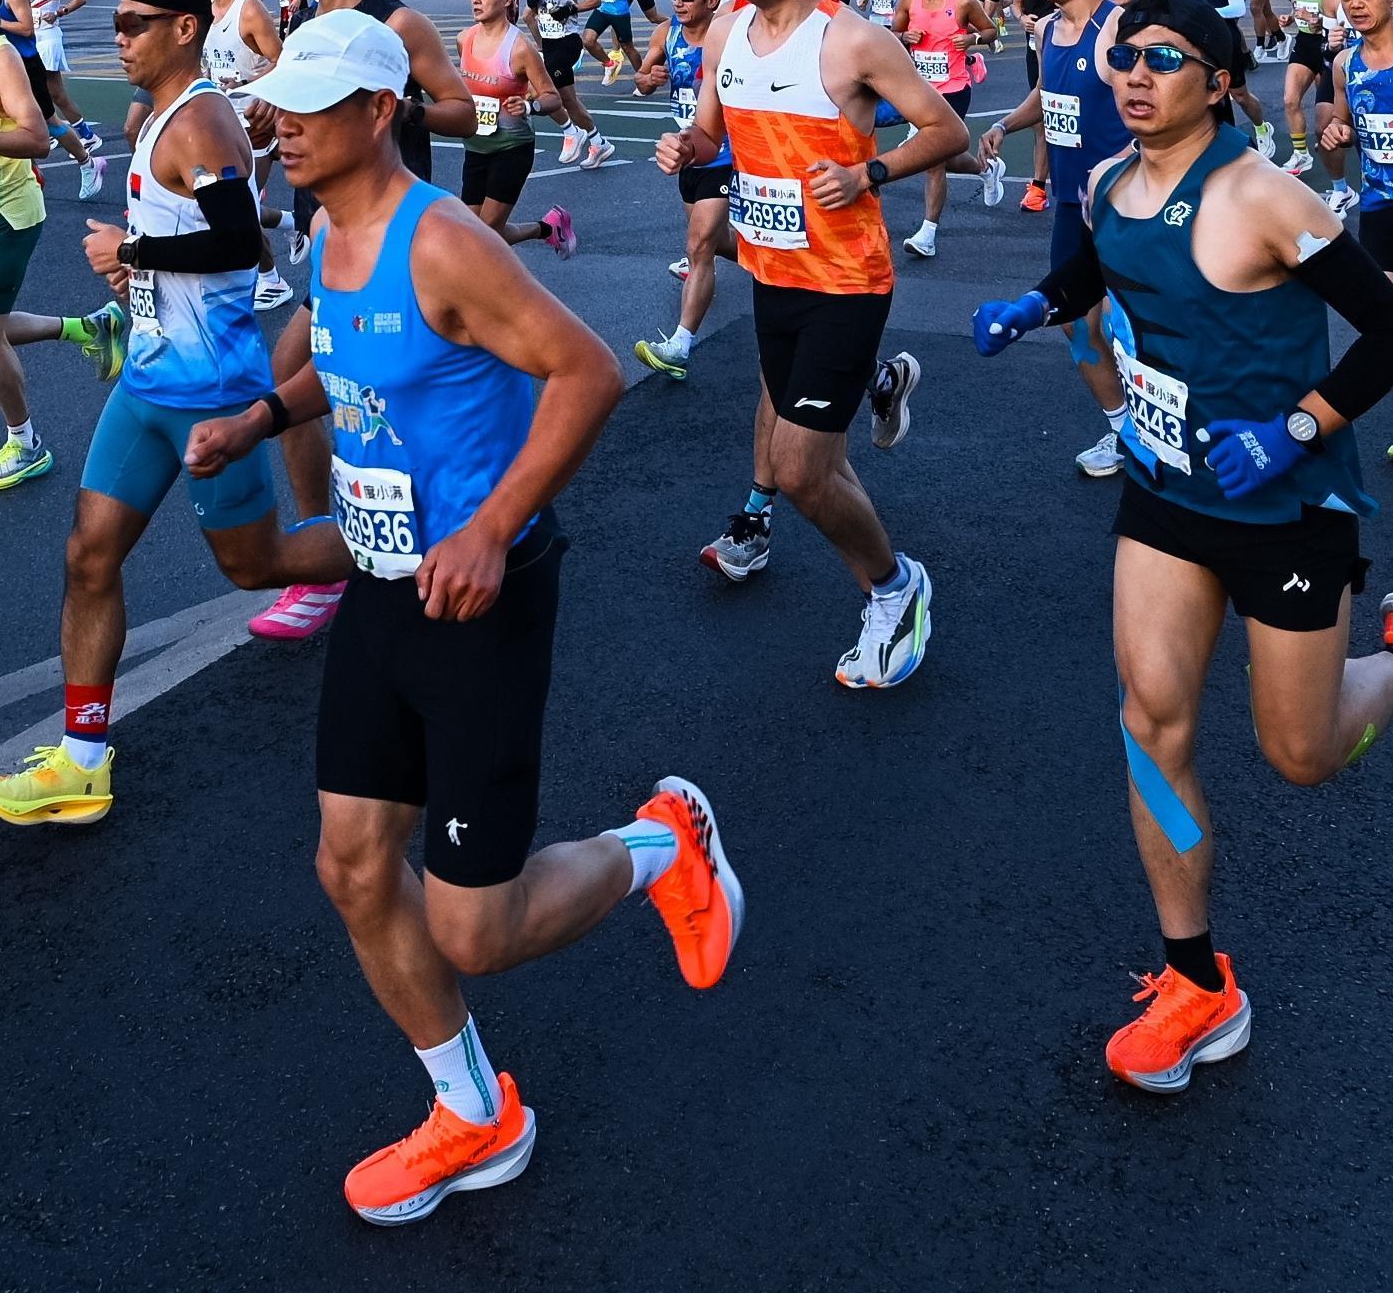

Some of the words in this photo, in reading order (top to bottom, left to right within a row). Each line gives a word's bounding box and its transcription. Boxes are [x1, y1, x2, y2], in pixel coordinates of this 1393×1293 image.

[1358, 116, 1366, 127] A
[731, 175, 739, 191] A
[742, 200, 801, 232] 26939
[363, 484, 404, 501] 度小满
[342, 499, 415, 554] 26936
